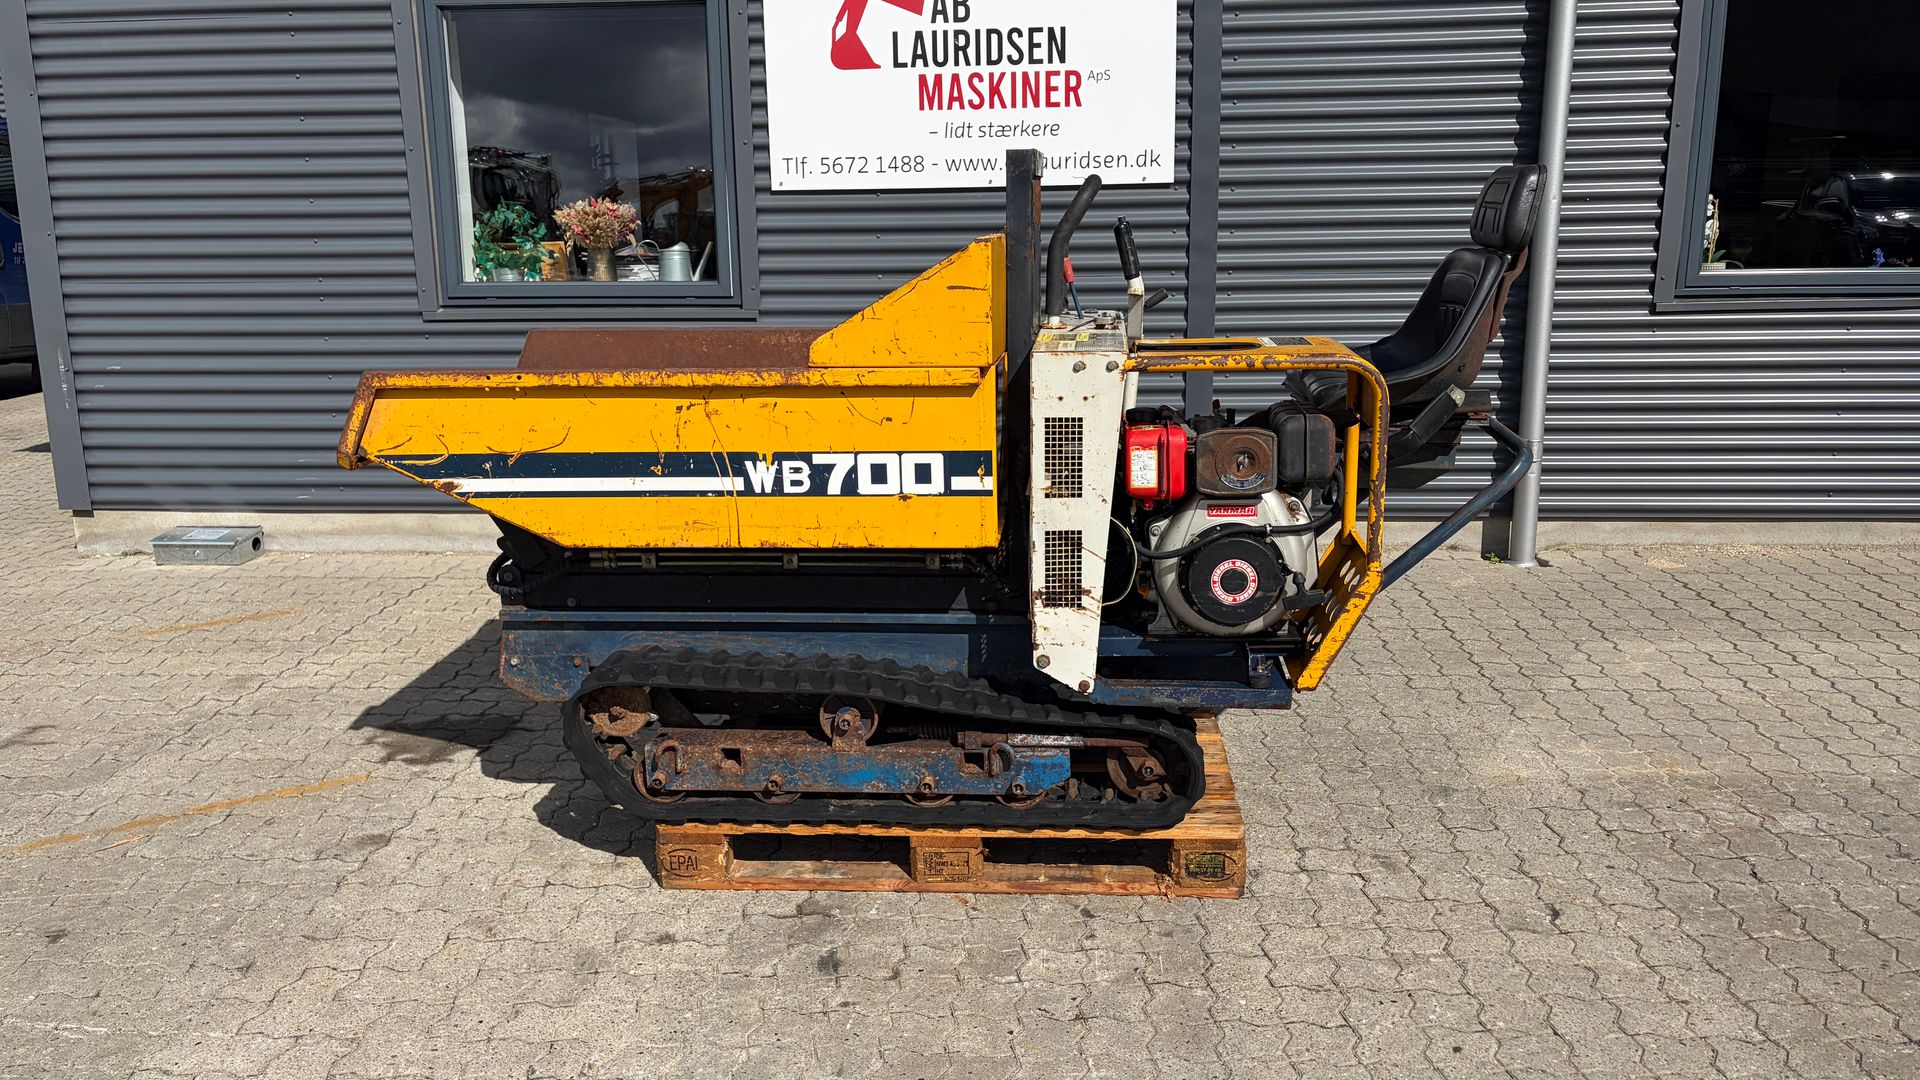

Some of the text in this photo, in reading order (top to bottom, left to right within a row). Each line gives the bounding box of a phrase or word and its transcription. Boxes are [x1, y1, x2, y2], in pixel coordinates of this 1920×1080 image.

[931, 0, 971, 24] AB
[892, 26, 1066, 68] LAURIDSEN
[918, 69, 1111, 111] MASKINER ApS
[944, 121, 973, 139] lidt
[978, 120, 1060, 137] stærkere
[782, 156, 812, 179] Tlf.
[820, 156, 869, 174] 5672
[876, 155, 925, 173] 1488
[1208, 506, 1256, 515] YANMAR
